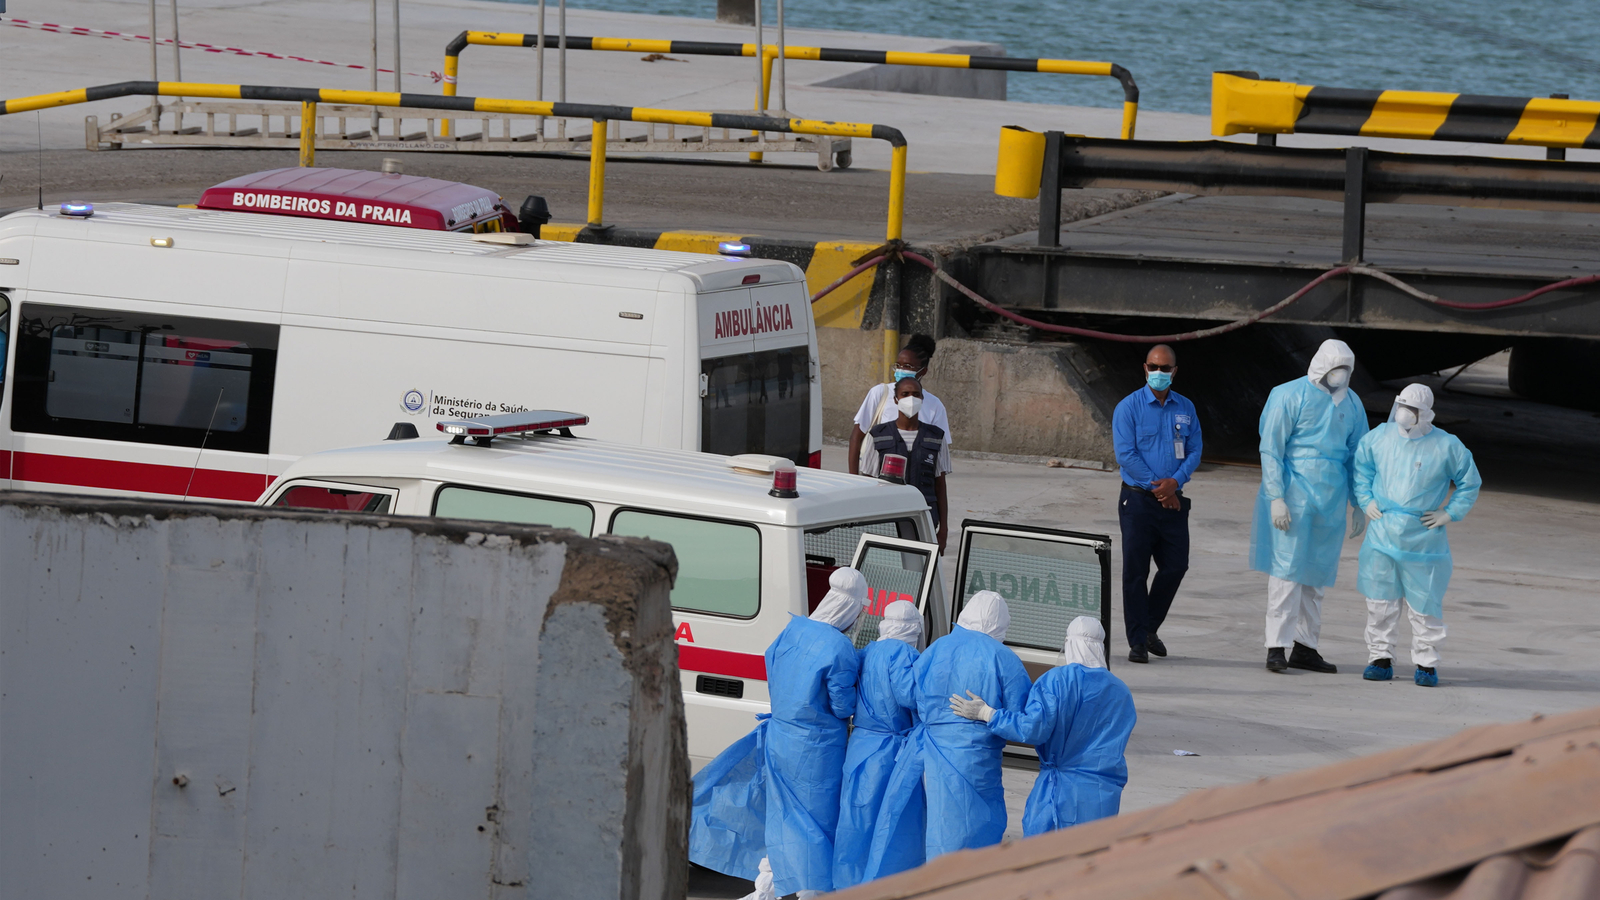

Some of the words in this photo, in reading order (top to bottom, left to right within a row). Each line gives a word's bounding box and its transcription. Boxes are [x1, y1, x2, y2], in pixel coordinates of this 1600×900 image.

[232, 192, 331, 214] BOMBEIROS
[335, 201, 357, 217] DA
[361, 204, 412, 224] PRAIA
[714, 300, 794, 339] AMBULÂNCIA
[432, 405, 445, 416] da
[434, 395, 482, 410] Ministério
[485, 401, 497, 411] da
